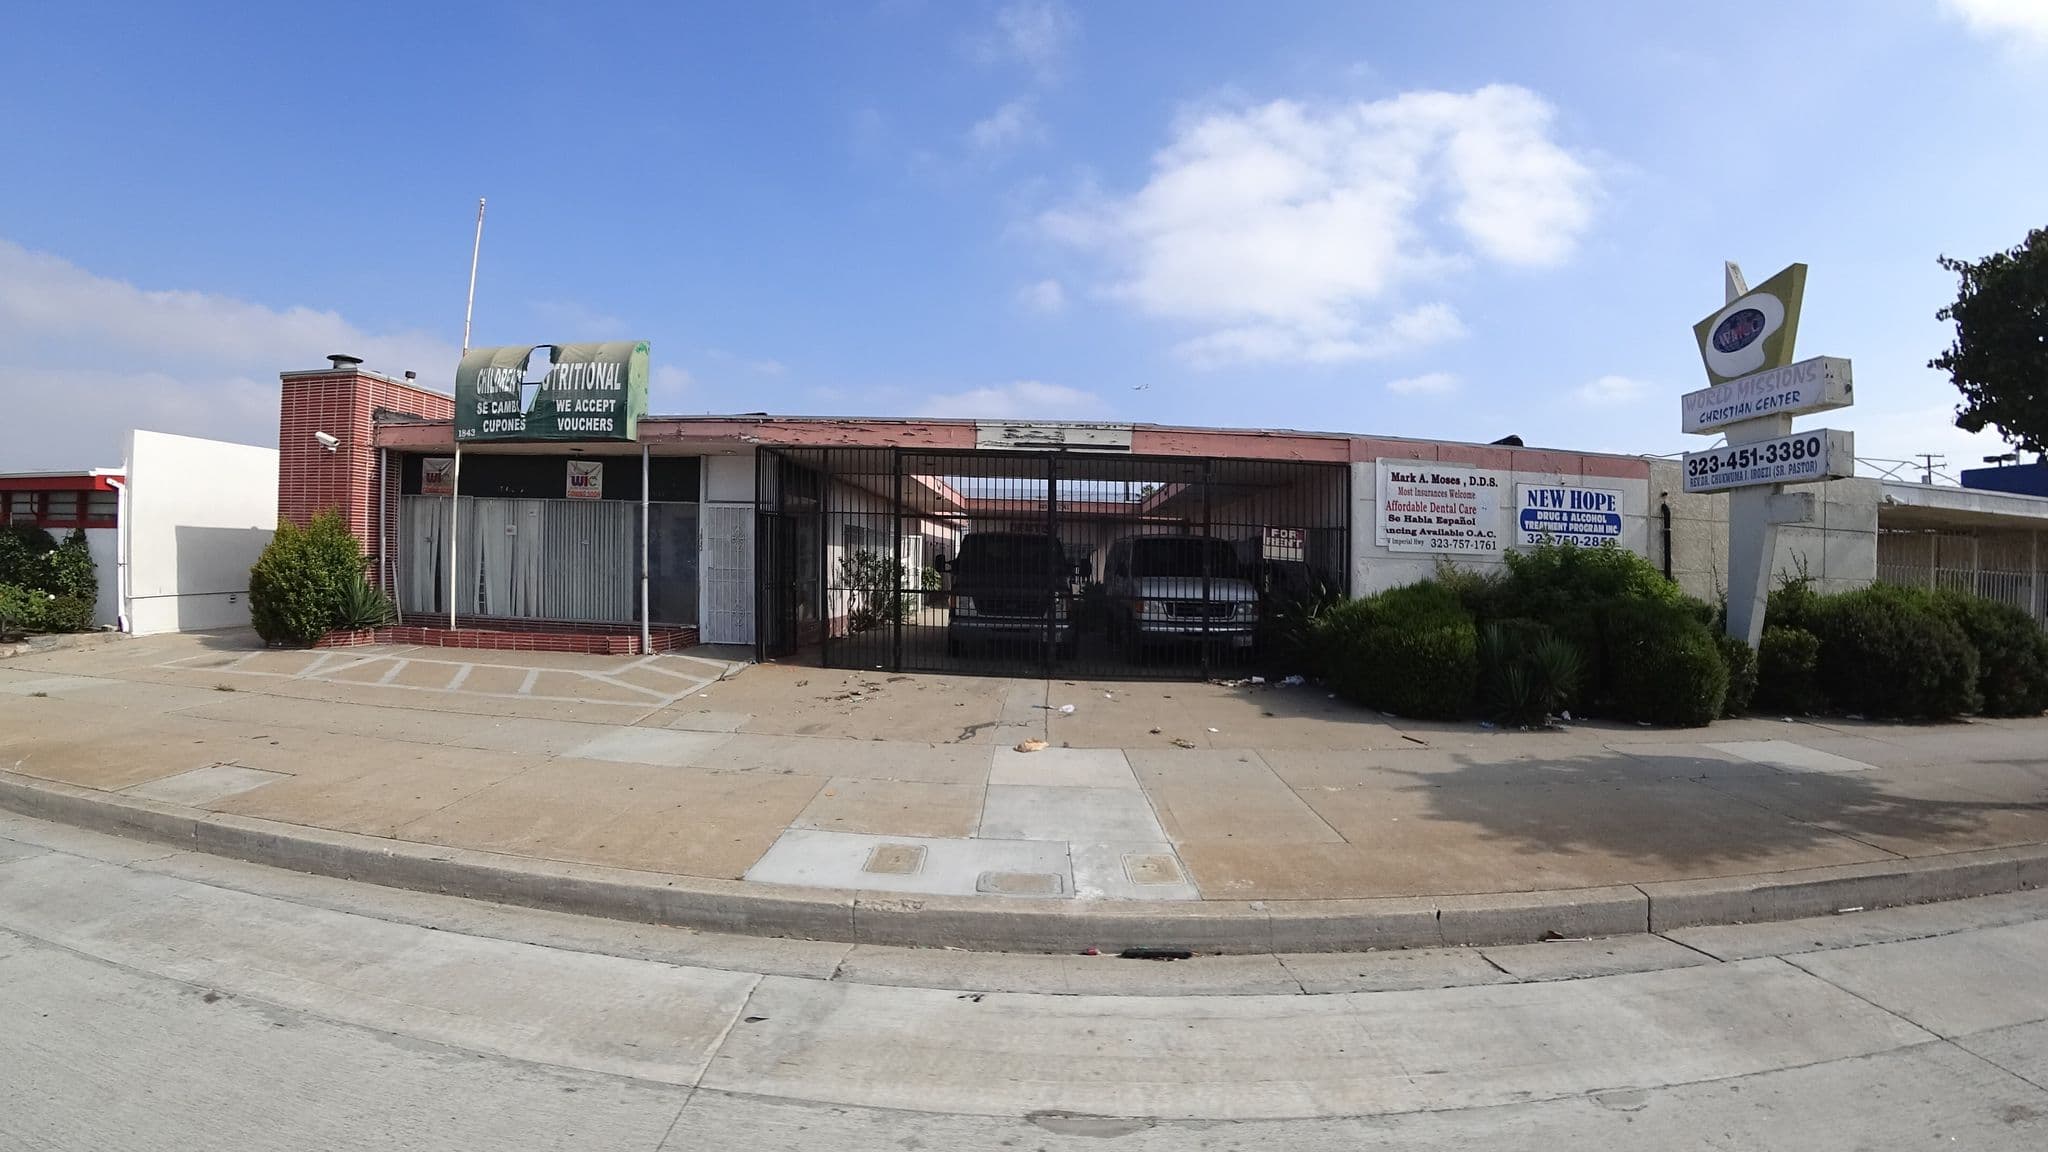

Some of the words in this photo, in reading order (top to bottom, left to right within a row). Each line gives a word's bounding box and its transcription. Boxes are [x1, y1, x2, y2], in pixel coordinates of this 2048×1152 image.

[1686, 387, 1731, 411] WORLD
[1737, 362, 1817, 397] MISSIONS
[477, 401, 489, 415] SE
[556, 399, 571, 413] WE
[575, 399, 616, 413] ACCEPT
[1700, 401, 1752, 423] CHRISTIAN
[1756, 390, 1801, 411] CENTER
[483, 418, 526, 433] CUPONES
[557, 418, 614, 432] VOUCHERS
[458, 428, 476, 438] 1843
[1689, 437, 1821, 477] 323-451-3380
[1788, 460, 1818, 475] PASTOR)
[1391, 472, 1416, 483] Mark
[1419, 473, 1429, 484] A.
[1431, 474, 1460, 485] Moses
[1469, 476, 1498, 487] D.D.S.
[1398, 486, 1413, 497] Most
[1415, 487, 1448, 498] Insurances
[1449, 489, 1476, 499] Welcome
[1386, 500, 1427, 512] Affordable
[1430, 502, 1456, 513] Dental
[1459, 503, 1477, 515] Care
[1528, 489, 1565, 509] NEW
[1570, 490, 1616, 512] HOPE
[1404, 515, 1433, 524] Habla
[1436, 516, 1476, 526] Español
[1537, 511, 1560, 521] DRUG
[1562, 512, 1569, 521] &
[1571, 513, 1607, 523] ALCOHOL
[1271, 528, 1297, 539] FOR
[1419, 528, 1464, 537] Available
[1466, 530, 1497, 538] O.A.C.
[1524, 520, 1567, 532] TREATMENT
[1569, 523, 1605, 534] PROGRAM
[1430, 538, 1496, 550] 323-757-1761
